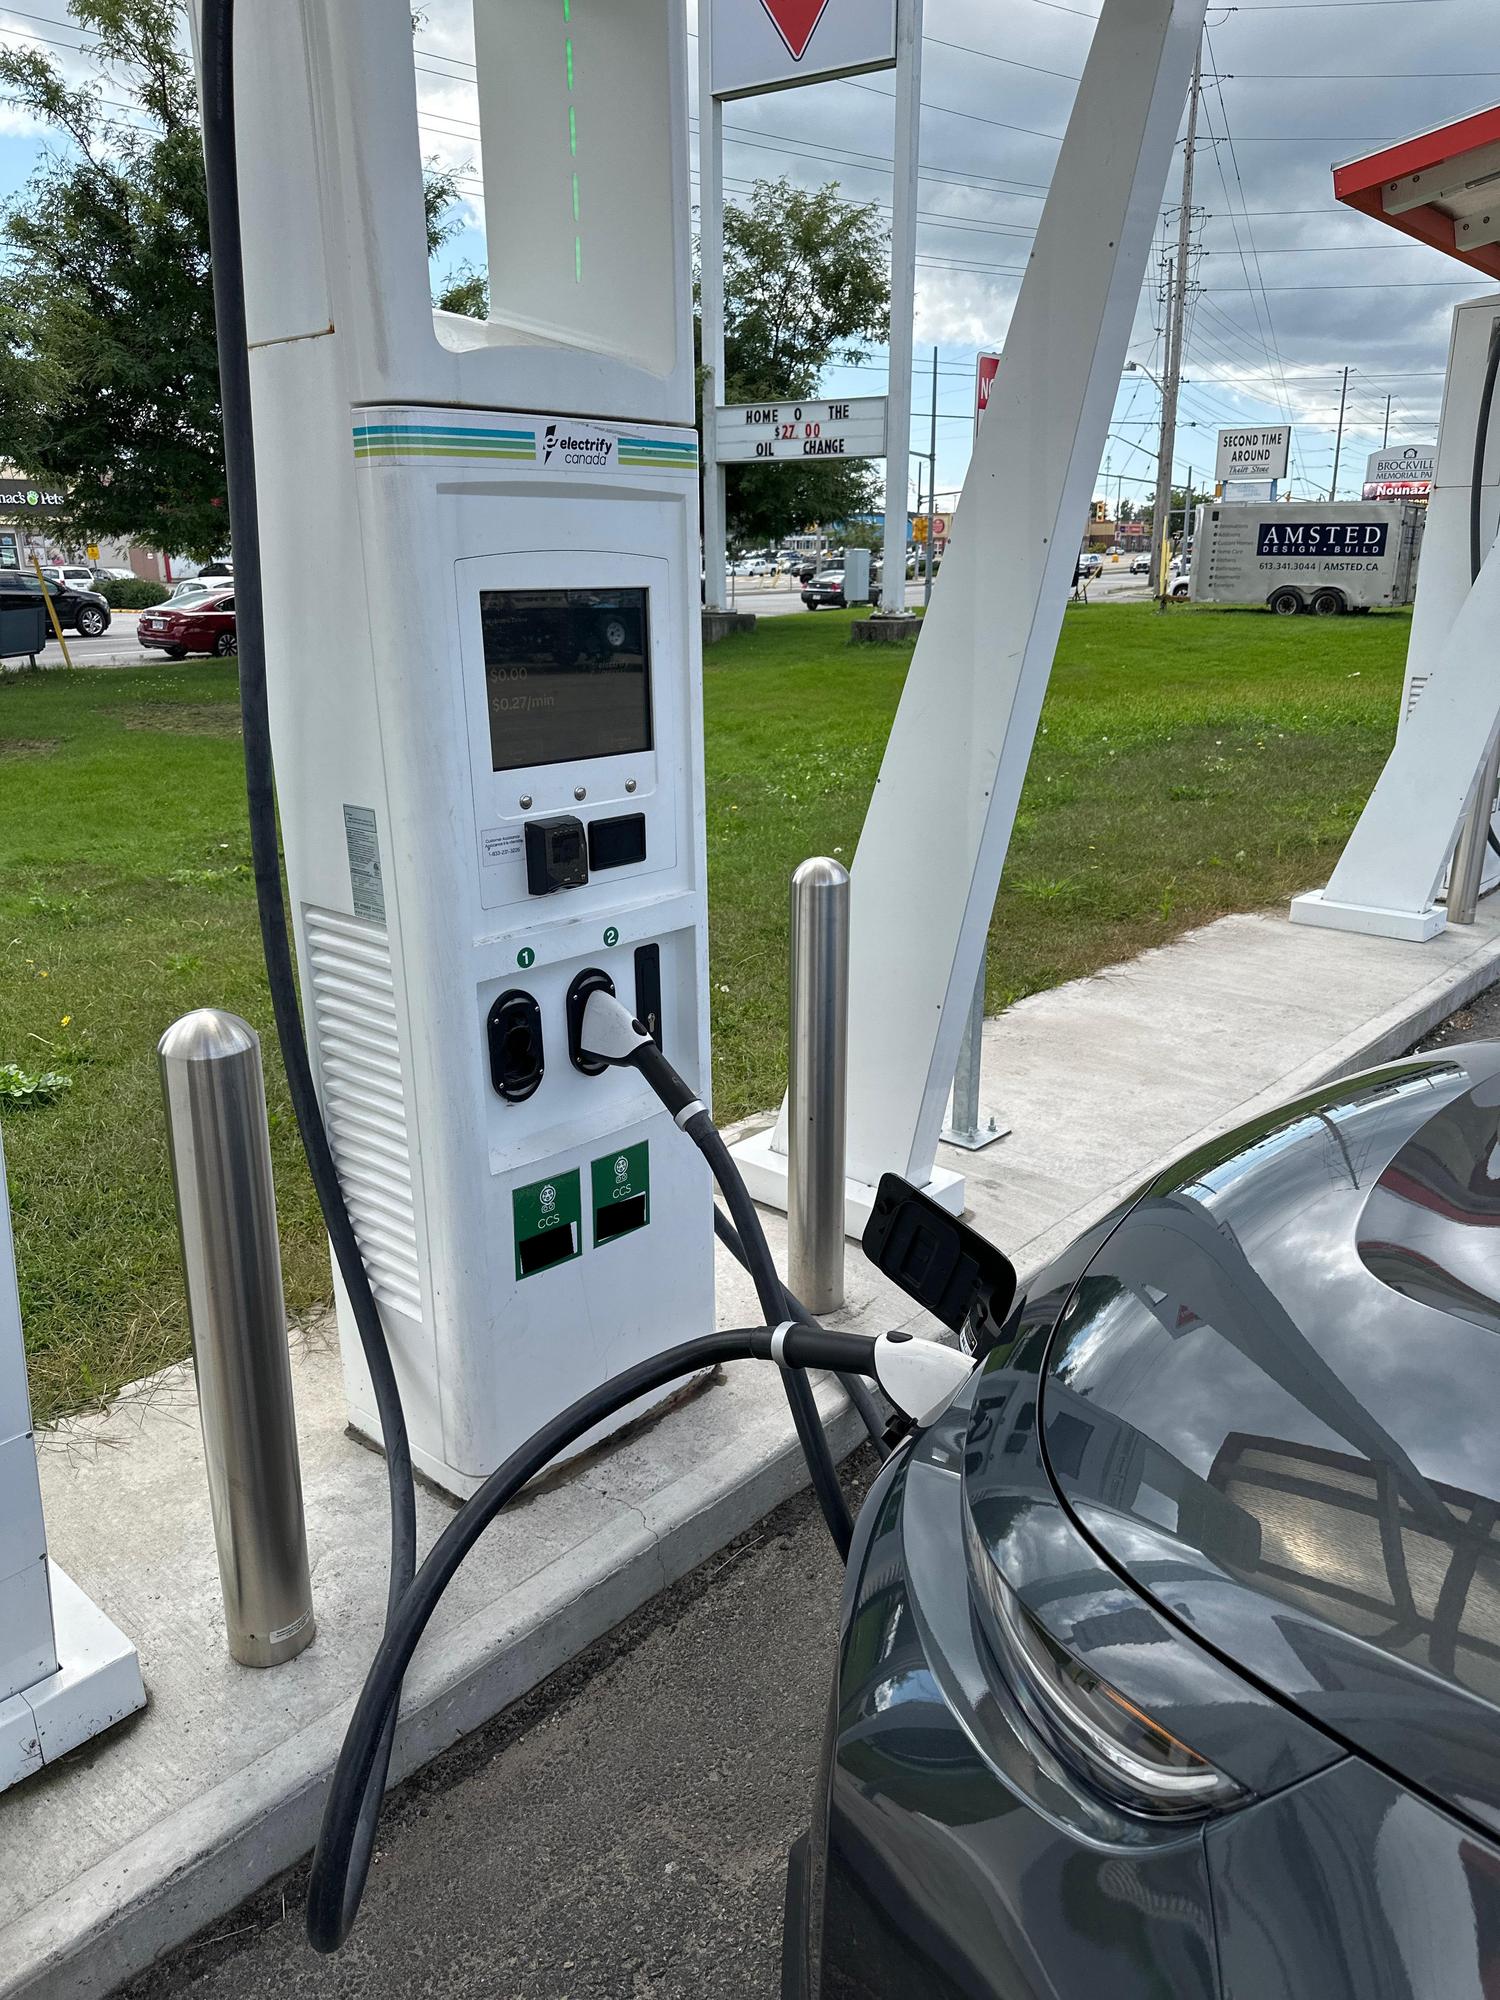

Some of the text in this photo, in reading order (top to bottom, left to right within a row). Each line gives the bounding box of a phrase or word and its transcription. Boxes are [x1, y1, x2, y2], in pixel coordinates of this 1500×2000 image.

[745, 409, 778, 424] HOME
[828, 404, 849, 419] THE
[560, 436, 612, 455] electrify
[756, 438, 845, 456] OIL CHANGE
[1223, 433, 1282, 447] SECOND TIME
[564, 452, 607, 466] canada
[1231, 449, 1270, 461] AROUND
[1375, 472, 1418, 480] MEMORIAL
[40, 491, 64, 505] Pets
[1264, 526, 1381, 544] AMSTED
[1259, 562, 1379, 571] 613.341.3044 AMSTED.CA
[489, 667, 528, 683] $0.00
[491, 693, 555, 712] $0.27/min
[606, 930, 616, 944] 2
[522, 952, 530, 965] 1
[612, 1183, 632, 1199] CCS
[537, 1213, 560, 1229] CCS
